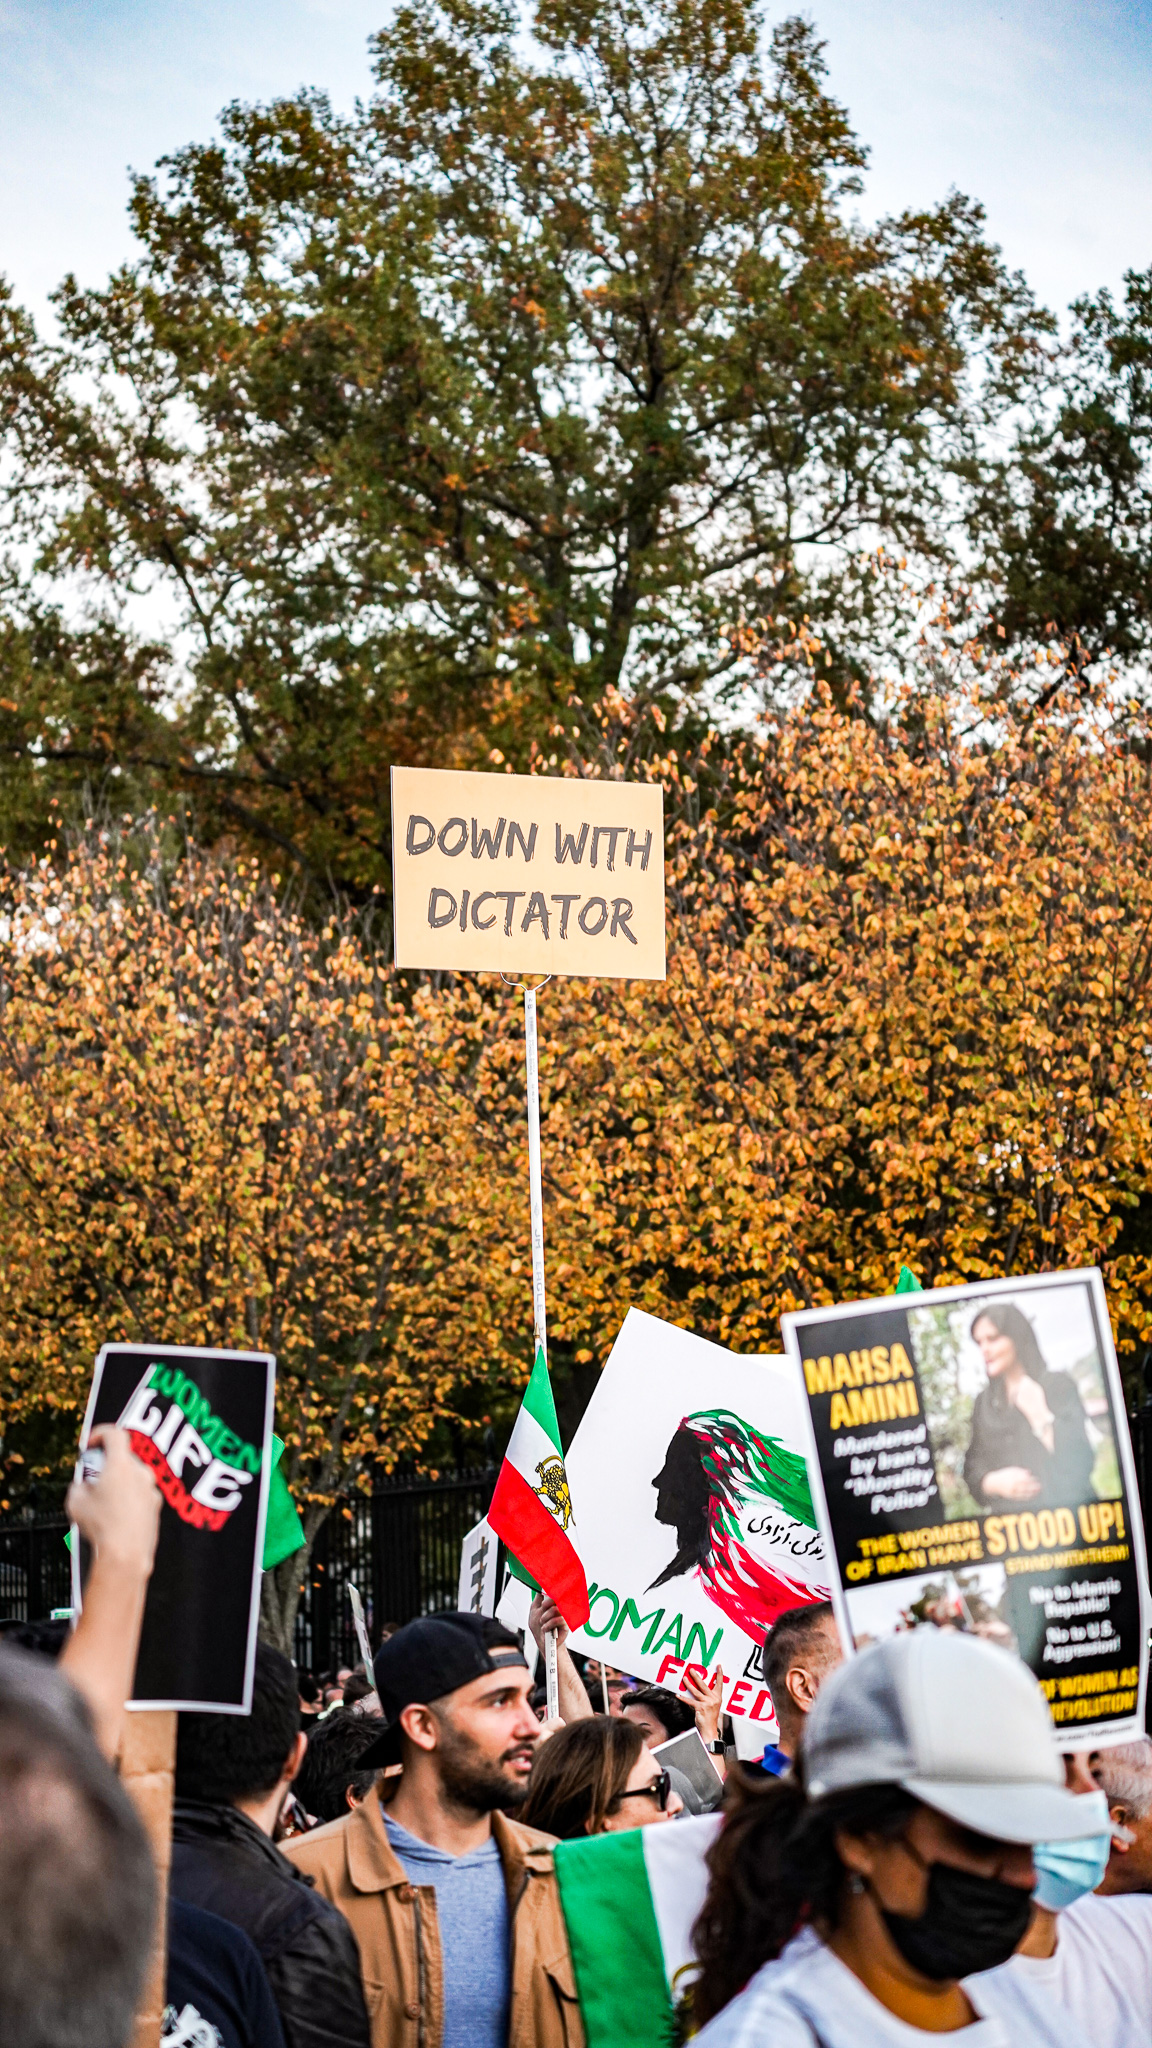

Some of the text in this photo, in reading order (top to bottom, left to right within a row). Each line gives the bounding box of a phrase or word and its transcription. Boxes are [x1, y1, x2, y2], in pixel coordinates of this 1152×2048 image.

[406, 814, 653, 872] DOWN WITH
[427, 887, 639, 945] DICTATOR
[803, 1342, 915, 1396] MAHSA
[145, 1362, 264, 1475] WOMEN
[829, 1379, 920, 1430] AMINI
[121, 1386, 254, 1512] LIFE
[833, 1423, 927, 1458] Murdered
[850, 1456, 877, 1478] by
[856, 1500, 1127, 1559] THE WOMEN STOOD UP!
[845, 1539, 984, 1582] OF IRAN HAVE
[1028, 1585, 1054, 1605] No
[1053, 1584, 1071, 1601] to
[582, 1583, 724, 1668] OMAN
[1045, 1625, 1070, 1646] No
[1069, 1625, 1087, 1642] to
